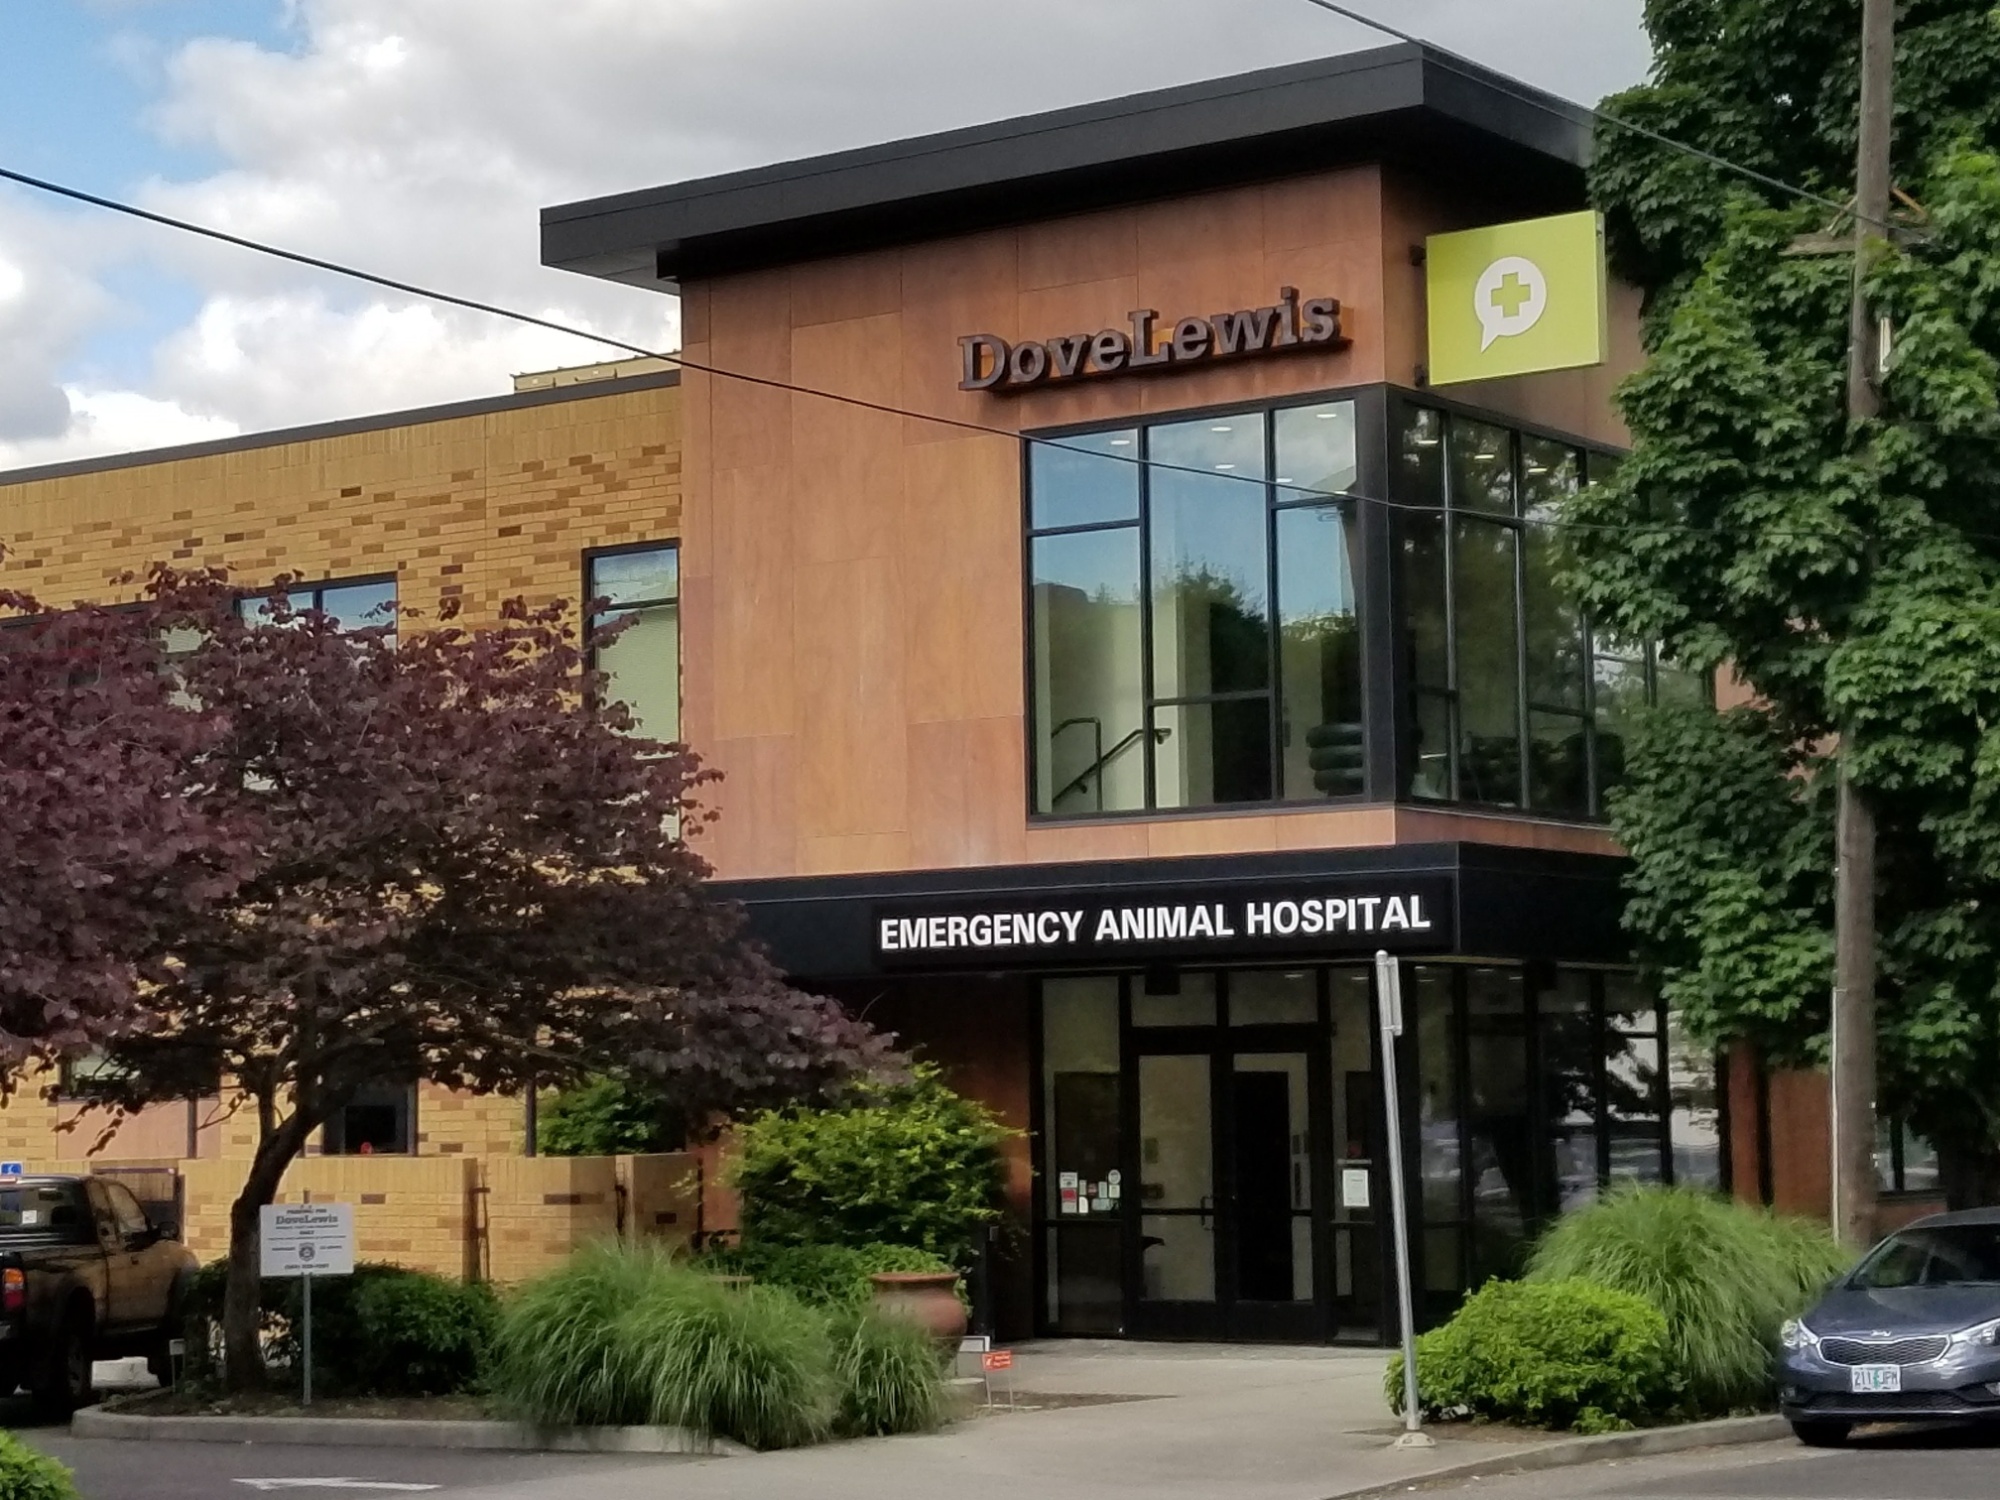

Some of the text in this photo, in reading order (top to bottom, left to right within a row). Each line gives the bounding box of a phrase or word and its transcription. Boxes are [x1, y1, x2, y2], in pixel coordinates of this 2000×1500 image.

[957, 286, 1340, 390] DoveLewis
[880, 895, 1431, 951] EMERGENCY ANIMAL HOSPITAL
[275, 1214, 339, 1225] DoveLewis
